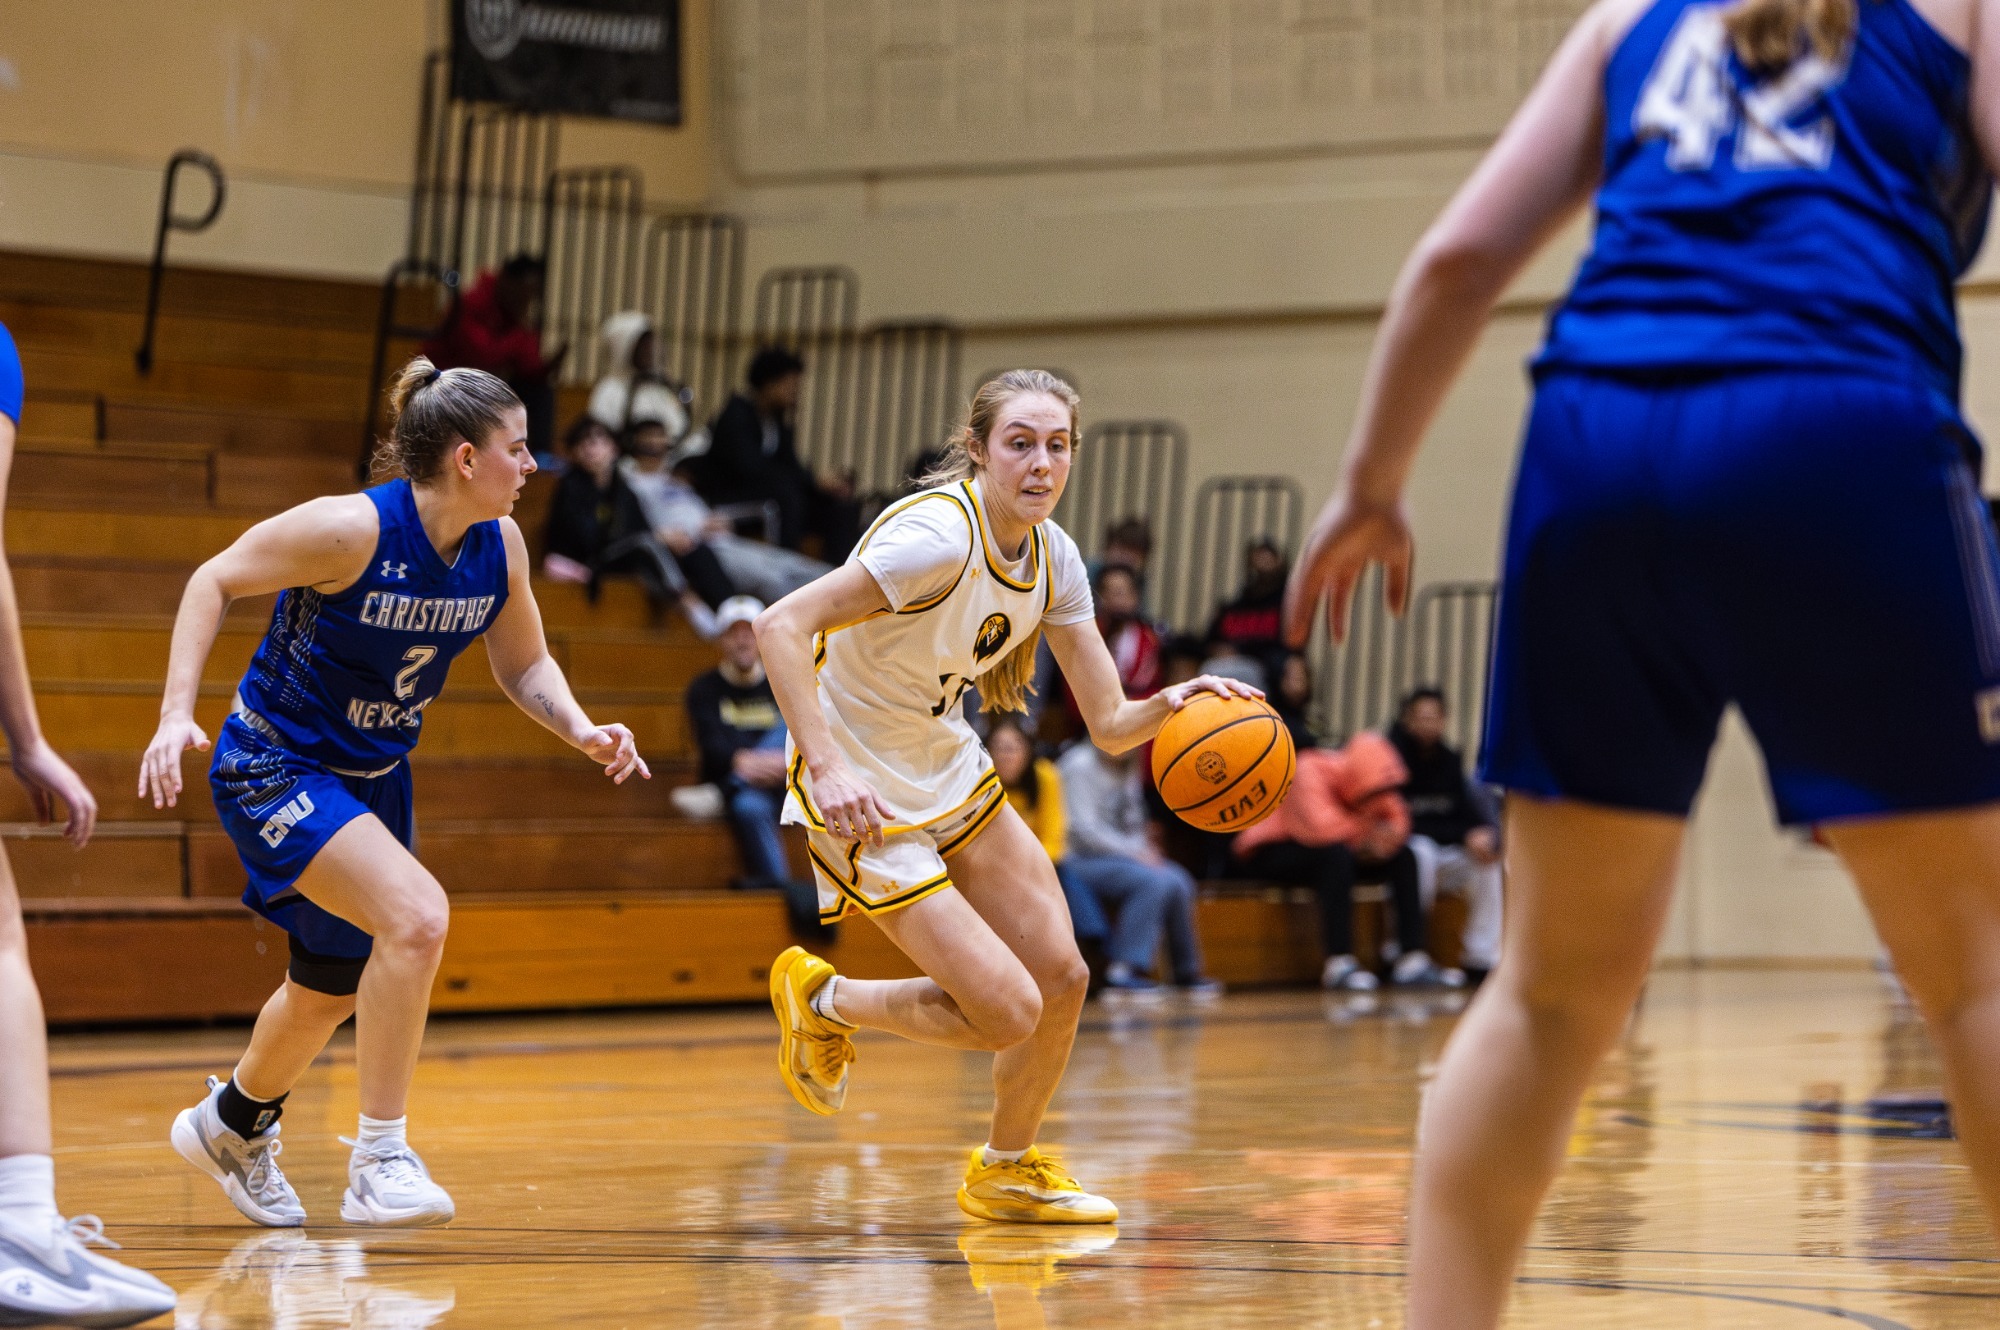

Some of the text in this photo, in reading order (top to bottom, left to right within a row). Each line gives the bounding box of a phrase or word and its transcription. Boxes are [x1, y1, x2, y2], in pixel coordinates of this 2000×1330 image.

[1631, 4, 1851, 172] 42
[394, 645, 438, 700] 2
[259, 791, 315, 848] CNU
